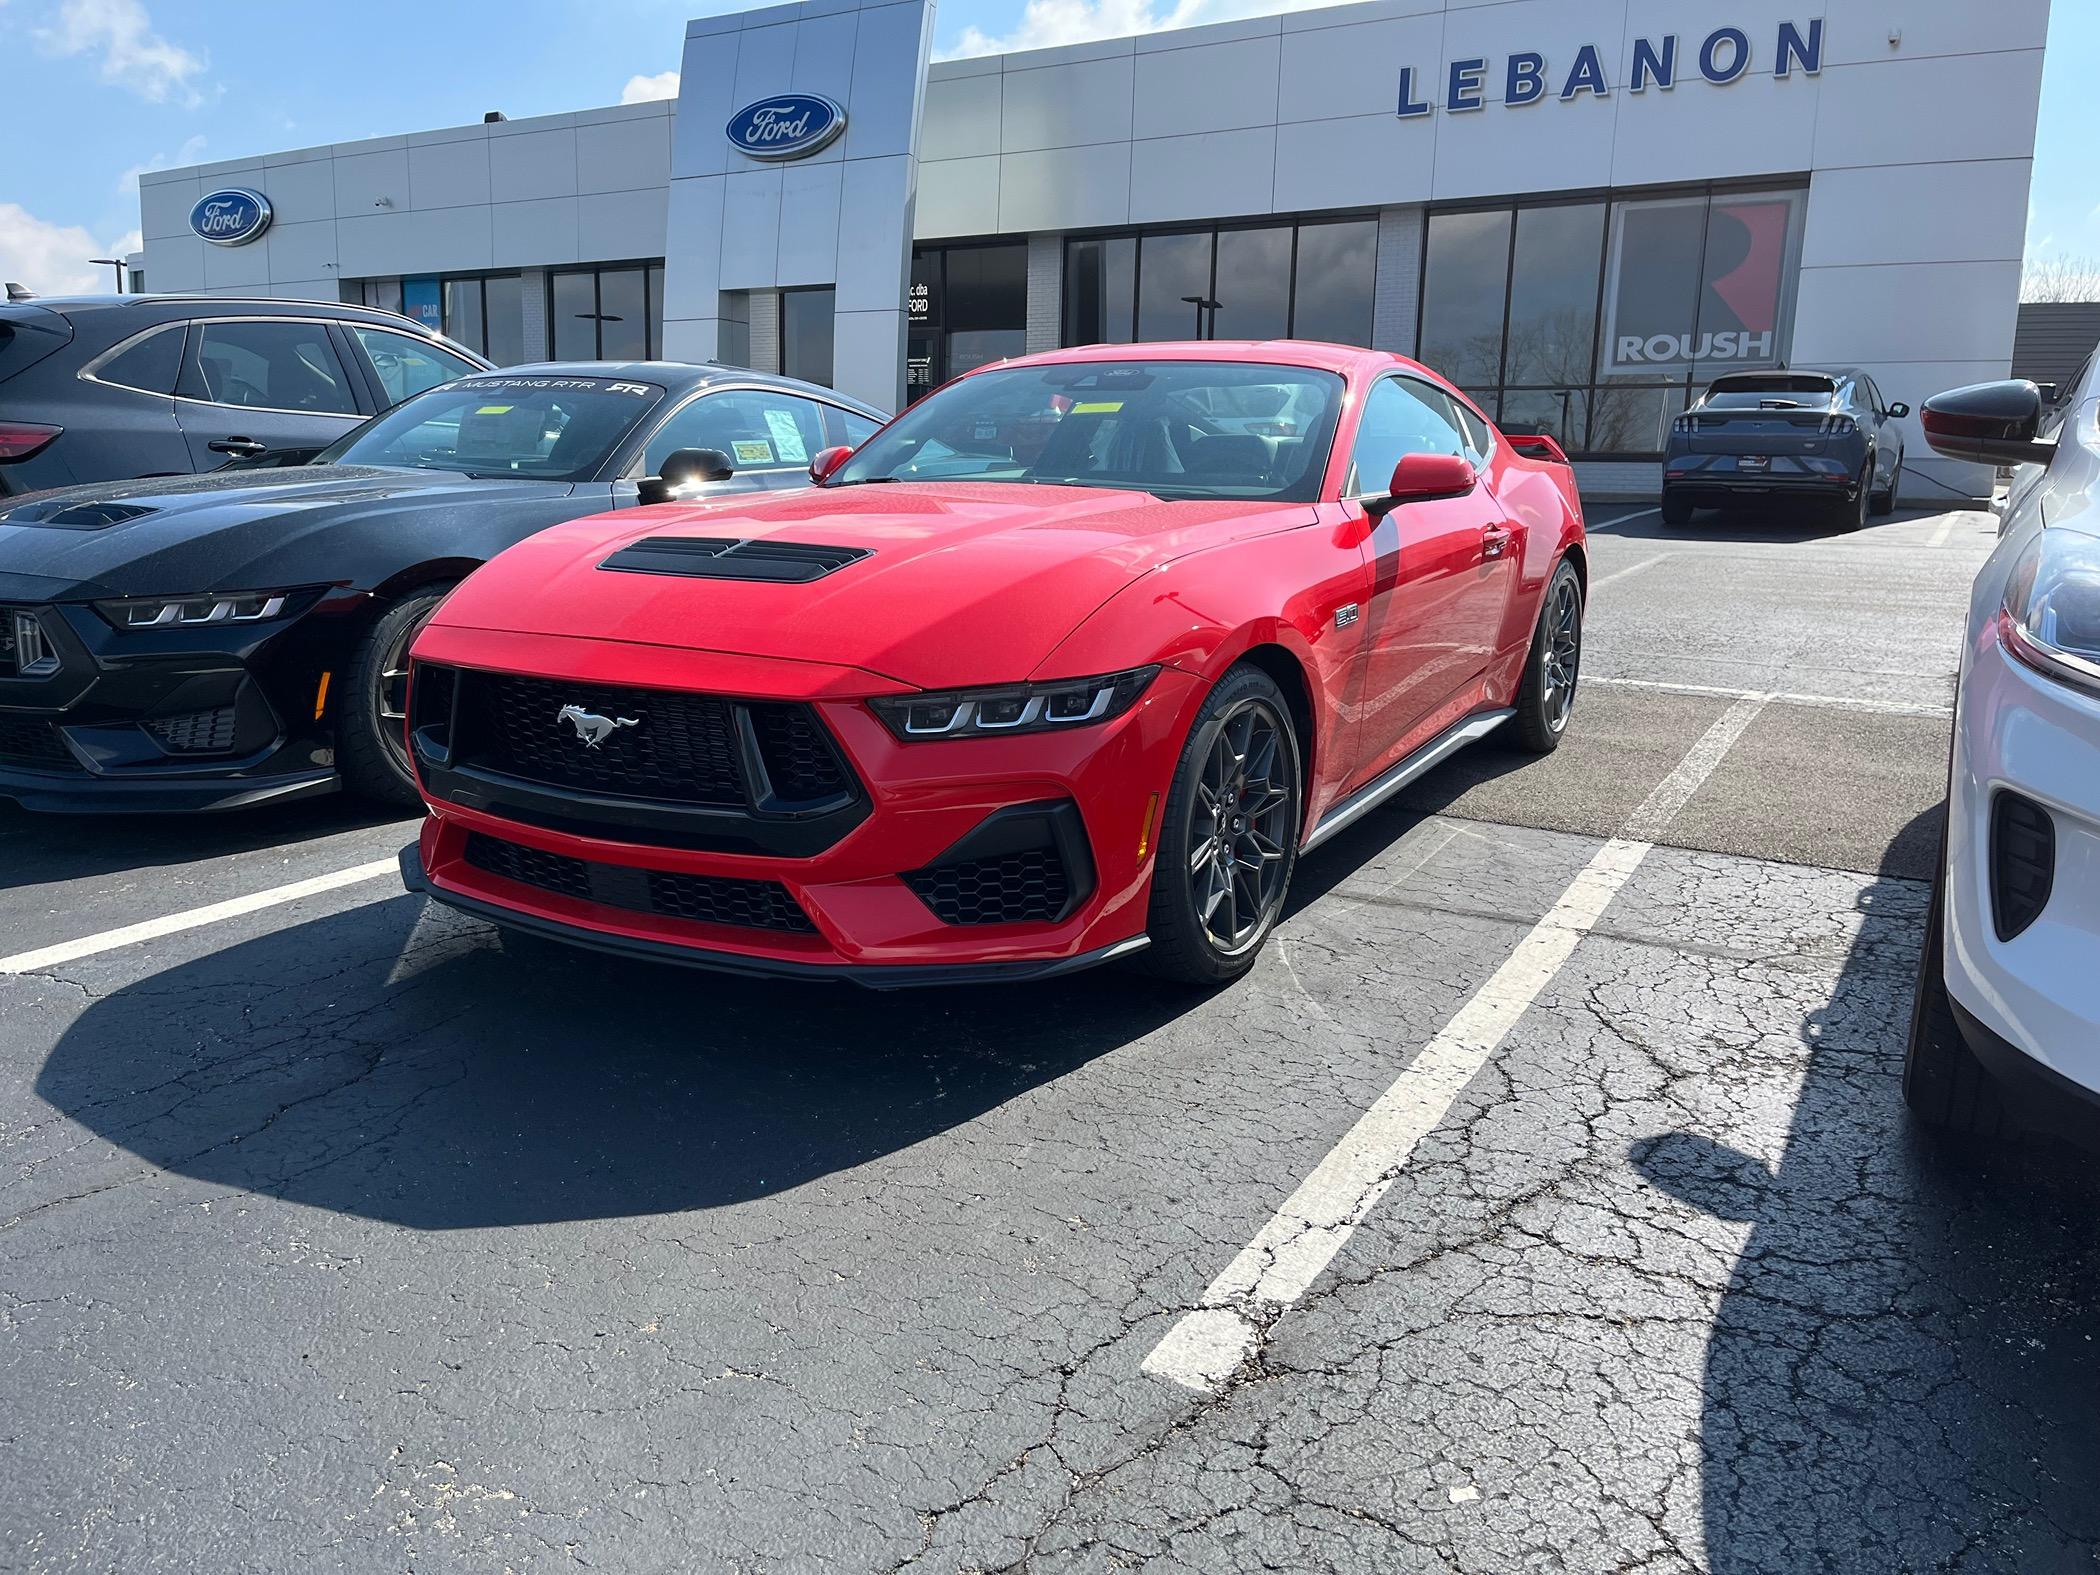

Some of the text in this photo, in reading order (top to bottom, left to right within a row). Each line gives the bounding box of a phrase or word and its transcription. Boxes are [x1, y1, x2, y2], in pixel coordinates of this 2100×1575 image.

[1396, 16, 1825, 118] LEBANON
[746, 105, 811, 143] Ford
[202, 200, 244, 233] Ford
[1616, 330, 1772, 362] ROUSH
[462, 380, 551, 388] MUSTANG
[551, 380, 596, 389] RTR
